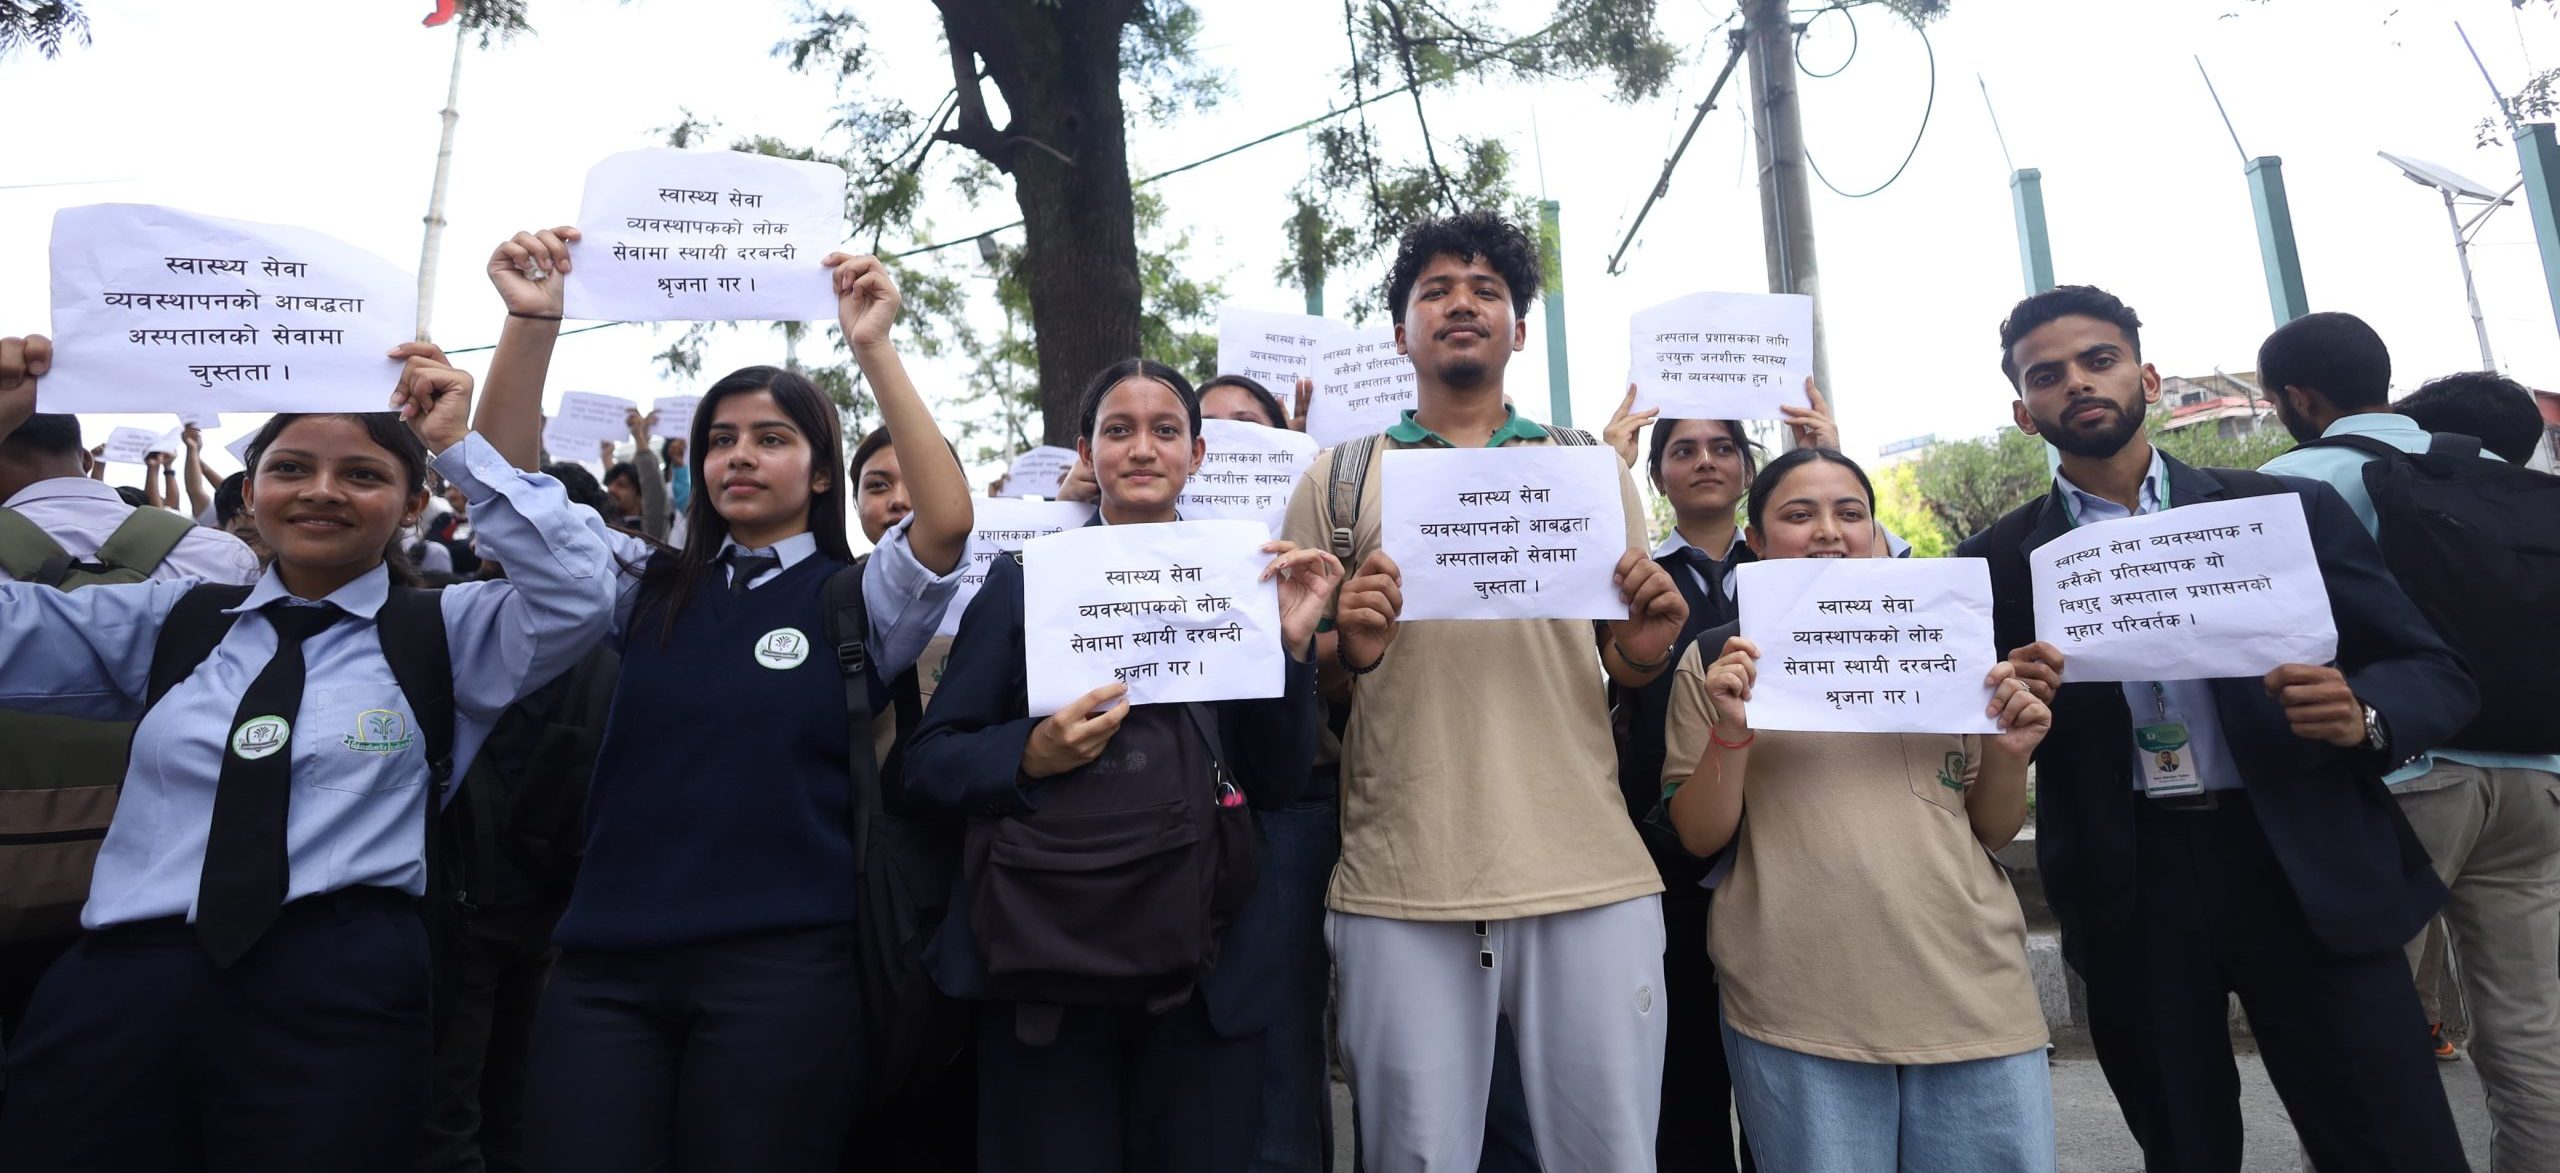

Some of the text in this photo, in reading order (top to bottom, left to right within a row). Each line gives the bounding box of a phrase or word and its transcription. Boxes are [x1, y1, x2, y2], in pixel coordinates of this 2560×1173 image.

[659, 189, 763, 208] स्वास्थ्य सेवा
[627, 218, 789, 235] व्यवस्थापकको लोक
[613, 242, 796, 260] सेवामा स्थायी दरबन्दी
[165, 256, 308, 278] स्वास्थ्य सेवा
[717, 278, 741, 292] गर
[103, 289, 364, 312] व्यवस्थापनको आबद्धता
[129, 324, 344, 345] अस्पतालको सेवामा
[1265, 334, 1295, 345] स्वास्थ्य
[1656, 333, 1789, 347] अस्पताल प्रशासकका लागि
[1249, 350, 1306, 367] व्यवस्थापकको
[1323, 348, 1351, 361] स्वास्थ्य
[1356, 344, 1374, 354] सेवा
[1657, 353, 1695, 365] उपयुक्त
[1752, 354, 1787, 366] स्वास्थ्य
[1661, 369, 1683, 381] सेवा
[1688, 373, 1746, 383] व्यवस्थापक
[1752, 374, 1768, 387] हुन
[1374, 389, 1412, 404] परिवर्तक
[1206, 450, 1293, 464] प्रशासकका लागि
[1254, 475, 1291, 484] स्वास्थ्य
[1191, 495, 1249, 505] व्यवस्थापक
[1256, 496, 1272, 509] हुन
[1458, 485, 1550, 506] स्वास्थ्य सेवा
[1420, 516, 1590, 537] व्यवस्थापनको आबद्धता
[1436, 545, 1577, 566] अस्पतालको सेवामा
[2054, 523, 2263, 570] स्वास्थ्य सेवा व्यवस्थापक न
[1105, 564, 1202, 585] स्वास्थ्य सेवा
[2056, 552, 2224, 589] कसैको प्रतिस्थापक यो
[2110, 588, 2177, 606] अस्पताल
[2186, 575, 2271, 598] प्रशासनको
[1079, 594, 1231, 619] व्यवस्थापकको लोक
[1817, 595, 1914, 614] स्वास्थ्य सेवा
[1792, 625, 1943, 645] व्यवस्थापकको लोक
[2064, 623, 2103, 642] मुहार
[2112, 611, 2180, 632] परिवर्तक
[1070, 622, 1243, 653] सेवामा स्थायी दरबन्दी
[1168, 661, 1191, 675] गर
[1784, 654, 1957, 675] सेवामा स्थायी दरबन्दी
[1883, 691, 1906, 704] गर
